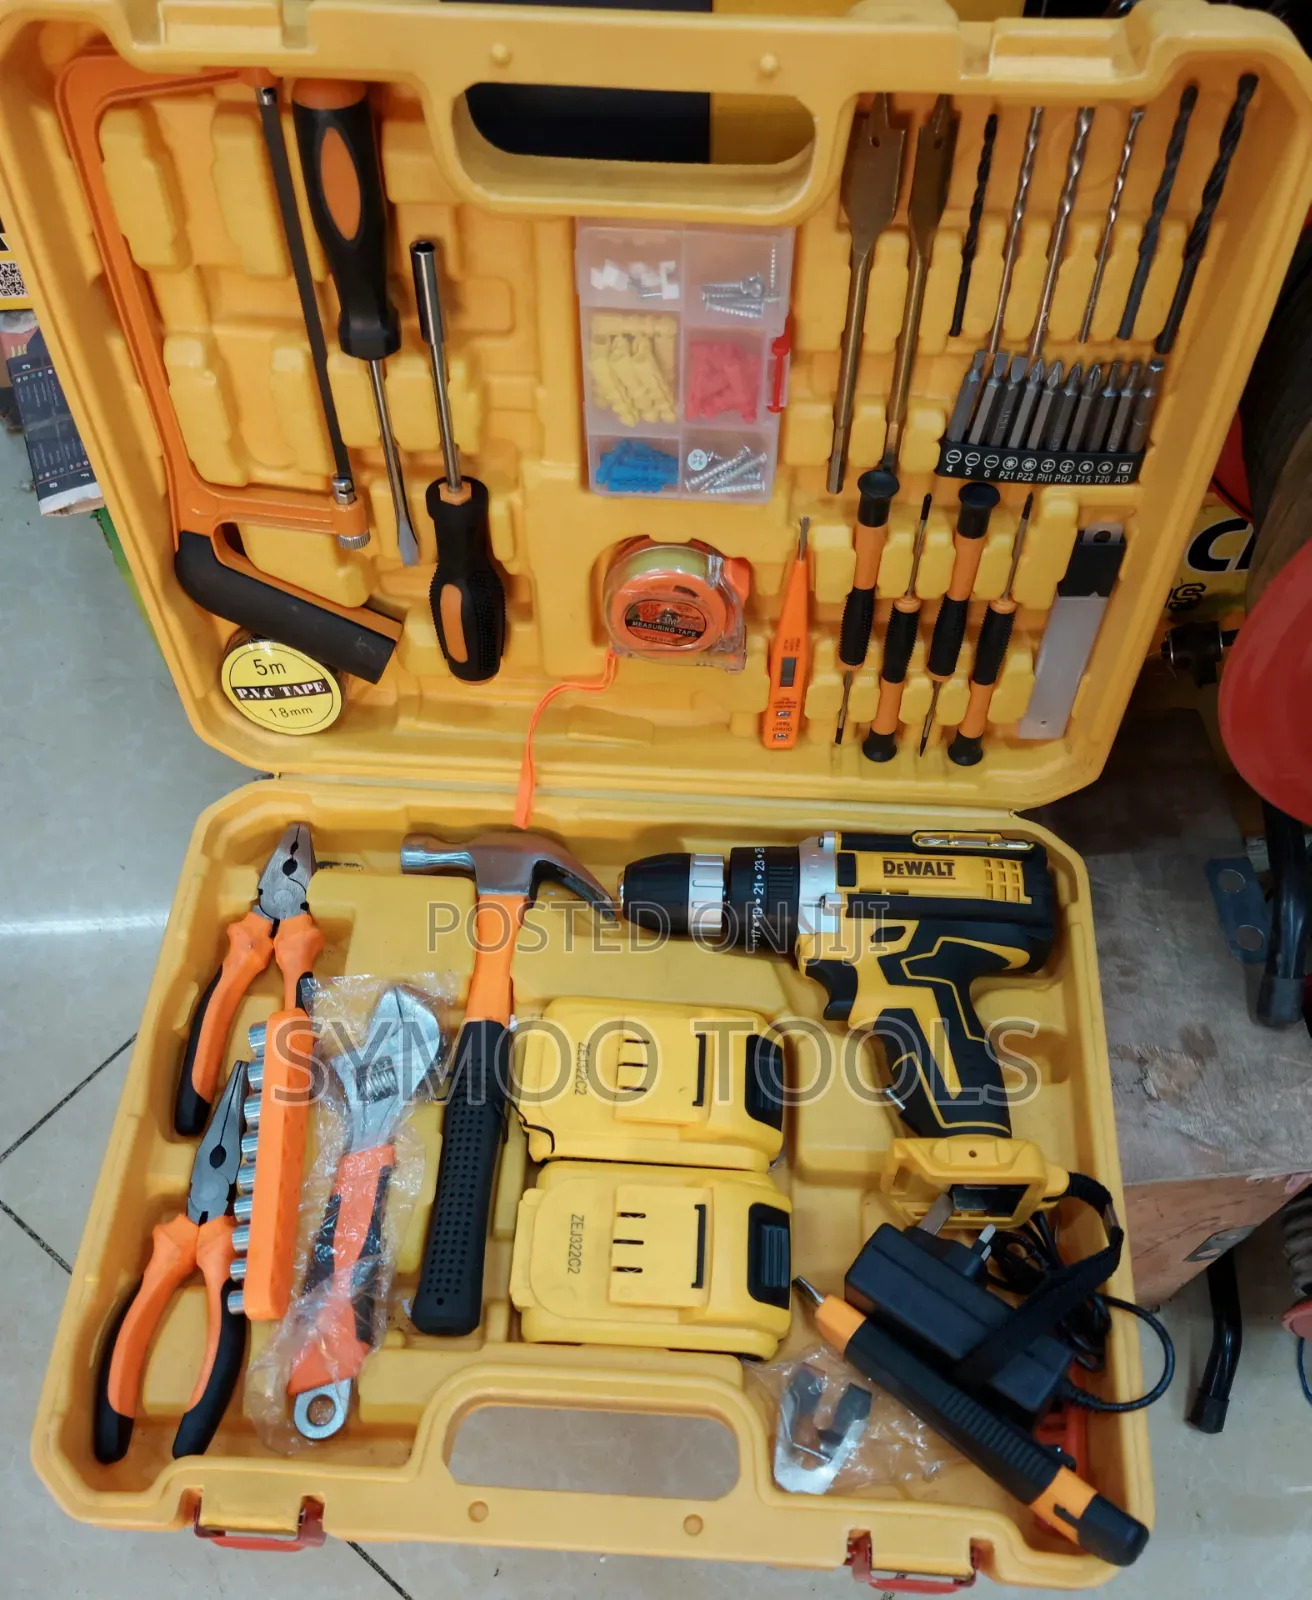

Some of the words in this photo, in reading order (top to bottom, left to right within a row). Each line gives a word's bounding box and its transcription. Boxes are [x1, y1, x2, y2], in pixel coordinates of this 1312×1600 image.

[945, 464, 954, 473] 4
[964, 467, 973, 476] 5
[983, 469, 991, 478] 6
[998, 471, 1015, 480] PZ1
[1016, 472, 1034, 481] PZ2
[1036, 473, 1053, 482] PH1
[1054, 474, 1073, 483] PH2
[1075, 474, 1092, 483] T15
[1094, 475, 1111, 484] T20
[1114, 475, 1130, 484] AD
[1184, 516, 1257, 573] C
[631, 620, 675, 633] MEASURING
[678, 628, 697, 637] TAPE
[253, 658, 287, 676] 5m
[235, 687, 276, 699] P.V.C
[279, 681, 326, 697] TAPE
[754, 859, 765, 872] 23
[882, 859, 955, 878] DEWALT
[753, 882, 764, 895] 21
[752, 907, 763, 918] 19
[567, 1213, 585, 1275] ZEJ322C2
